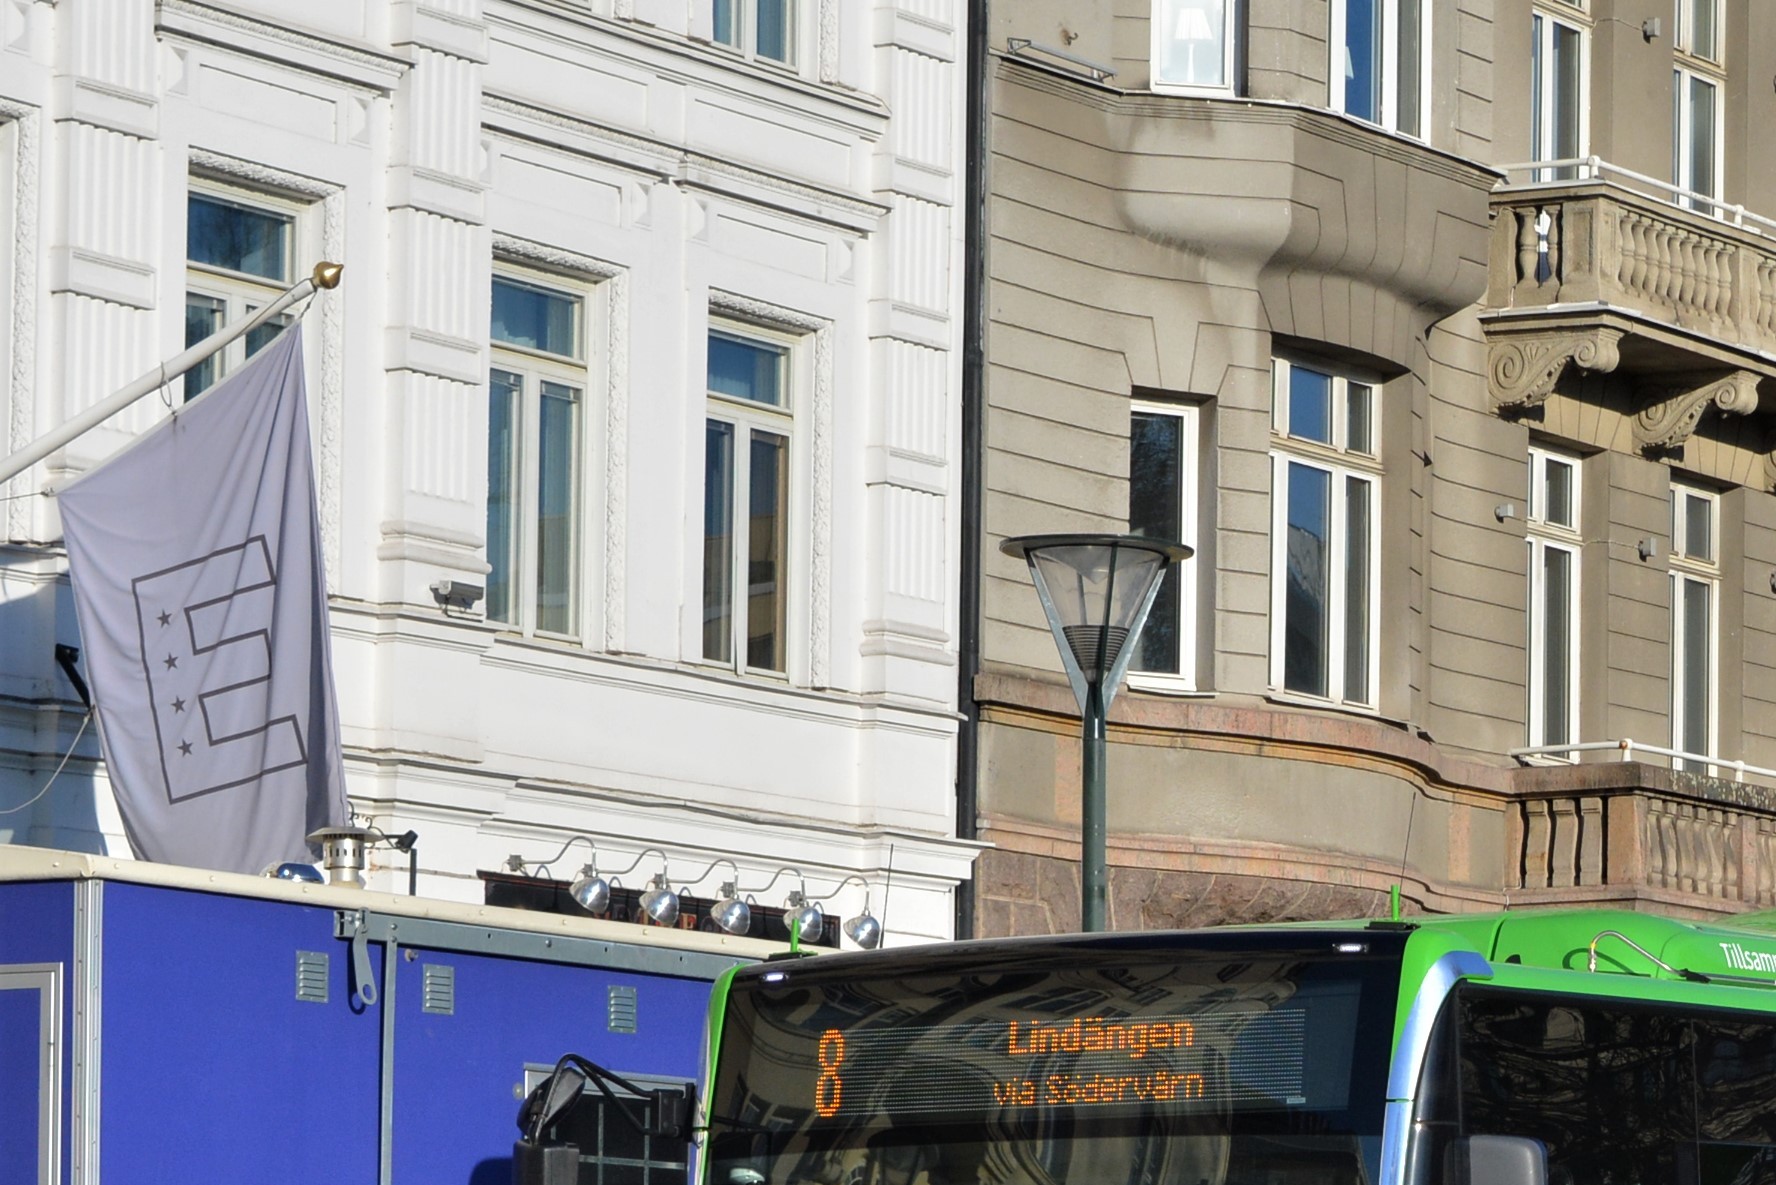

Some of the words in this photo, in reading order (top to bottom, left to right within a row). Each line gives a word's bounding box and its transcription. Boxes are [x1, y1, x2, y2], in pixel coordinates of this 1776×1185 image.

[1009, 1017, 1194, 1059] Lindängen
[815, 1029, 845, 1117] 8
[994, 1076, 1034, 1105] via
[1045, 1070, 1203, 1104] Södervärn
